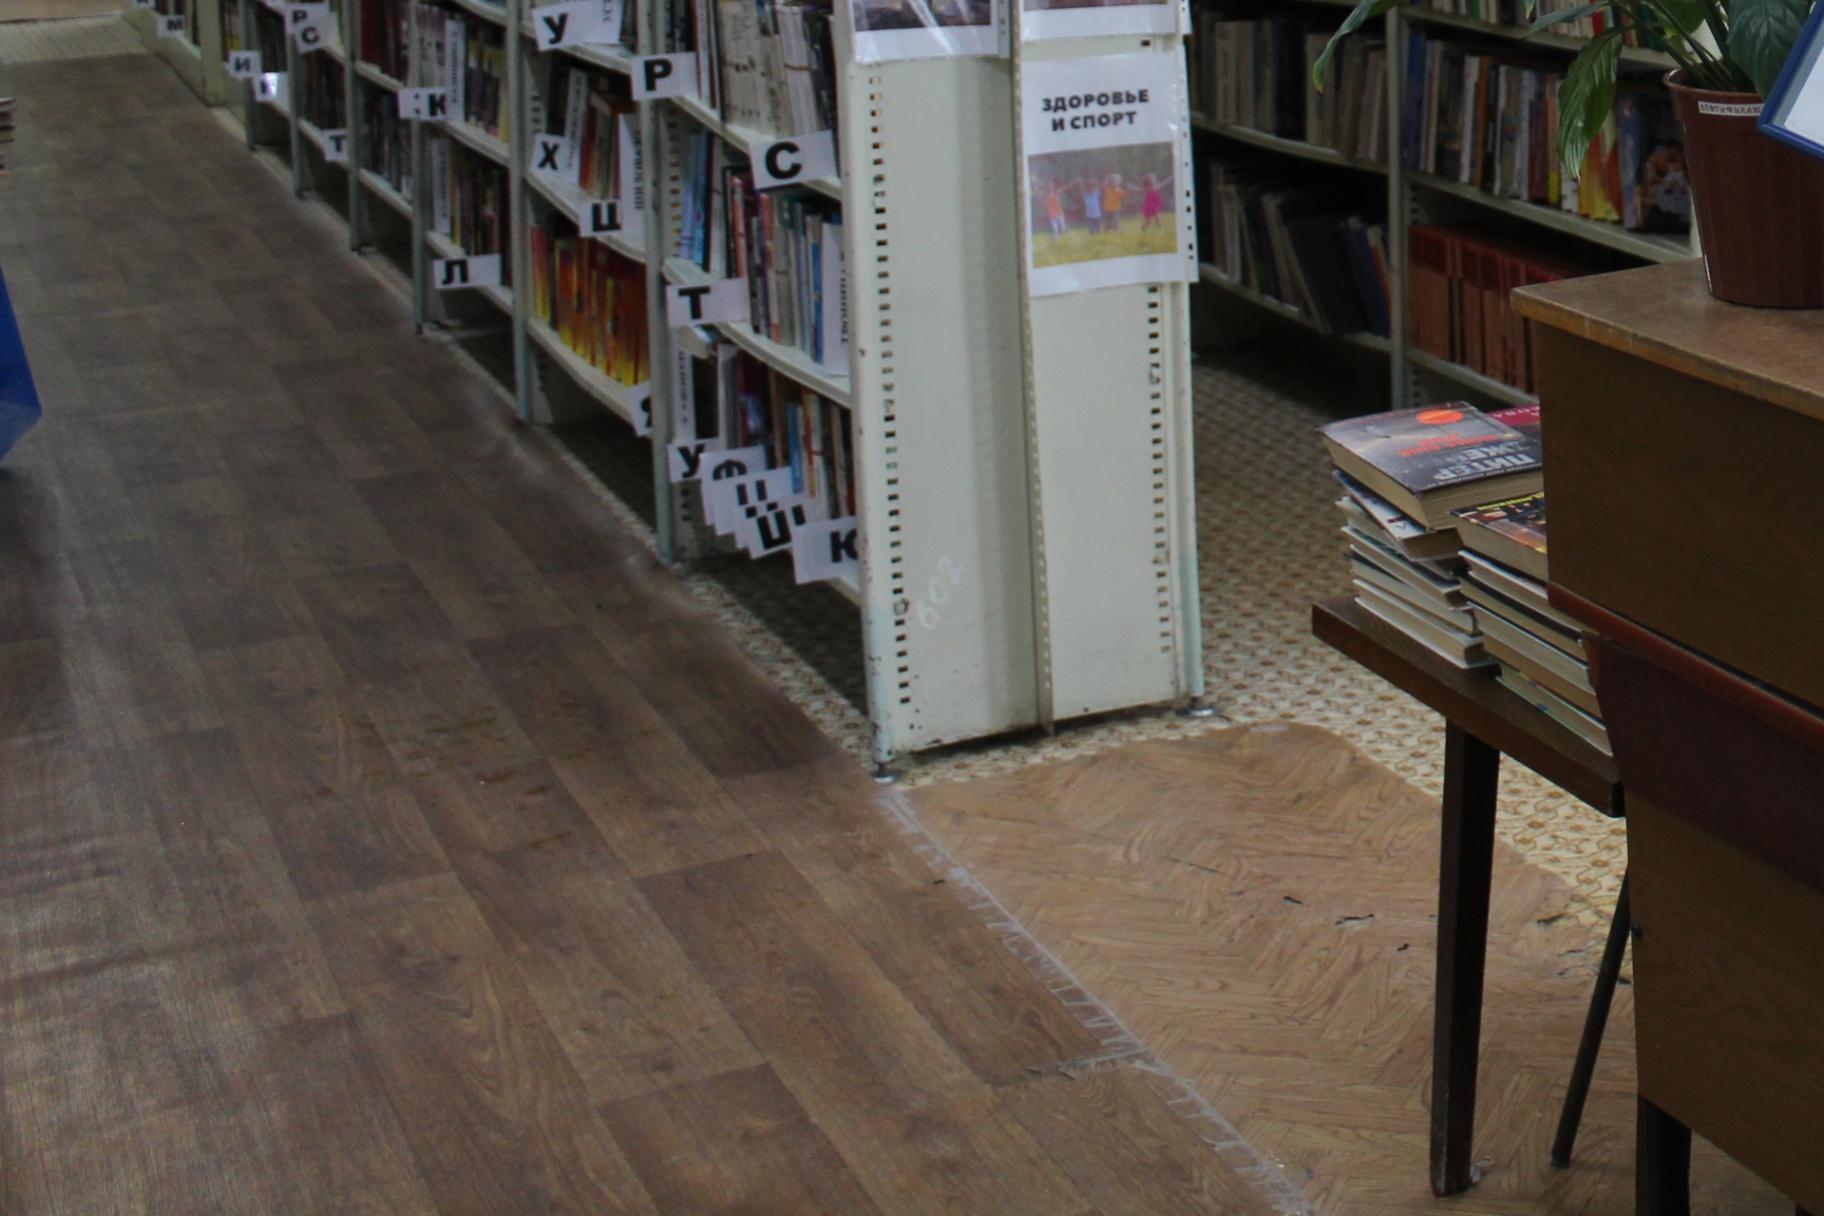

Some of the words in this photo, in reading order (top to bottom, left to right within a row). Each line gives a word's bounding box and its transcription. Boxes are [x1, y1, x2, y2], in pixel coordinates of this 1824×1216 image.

[302, 27, 319, 44] С
[543, 12, 569, 44] У
[643, 58, 673, 92] Р
[428, 92, 446, 117] К
[1042, 88, 1150, 112] ЗДОРОВЬЕ
[1052, 116, 1066, 131] И
[1069, 112, 1138, 131] СПОРТ
[330, 134, 347, 152] Т
[538, 141, 559, 170] Х
[765, 140, 802, 179] С
[591, 202, 621, 232] Ц
[442, 259, 468, 284] Л
[678, 286, 711, 320] Т
[678, 443, 705, 478] У
